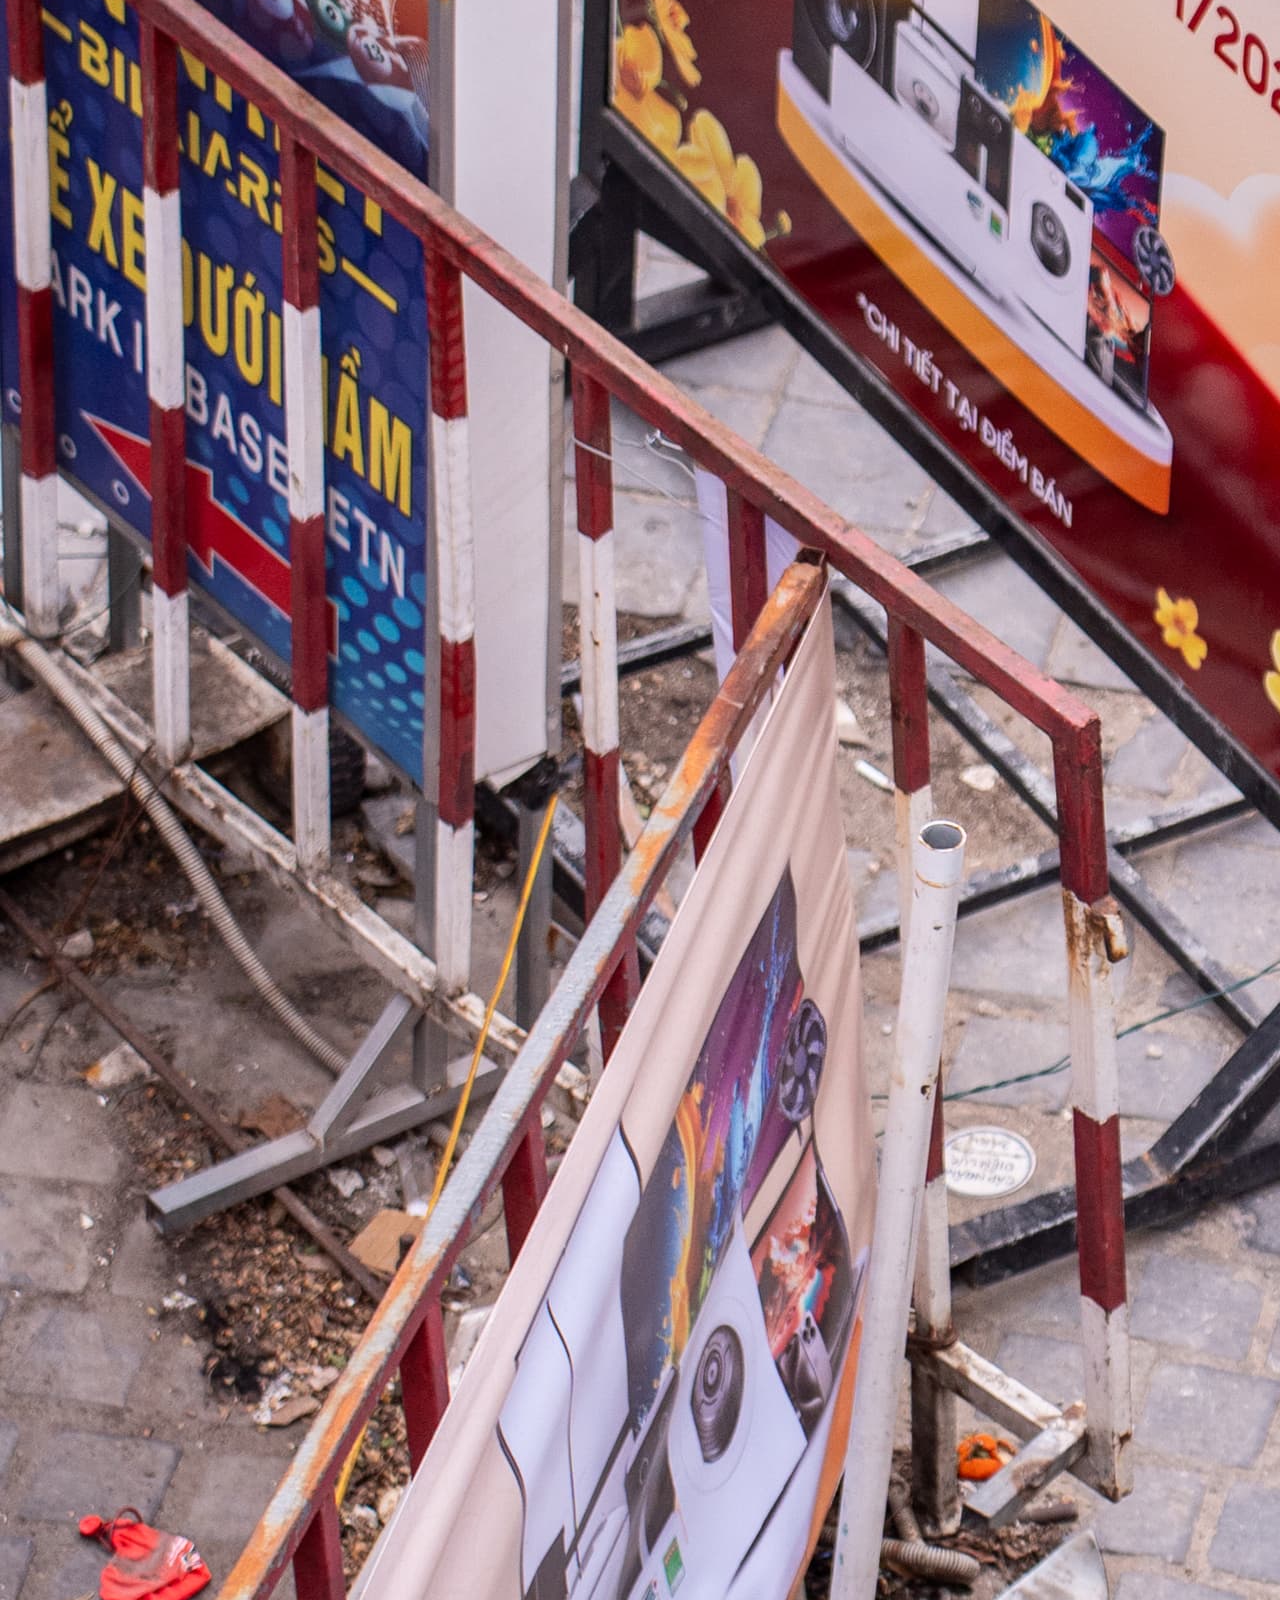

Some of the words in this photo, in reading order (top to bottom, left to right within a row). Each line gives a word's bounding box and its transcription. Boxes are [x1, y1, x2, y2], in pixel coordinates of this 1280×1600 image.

[322, 343, 413, 519] ẦM
[903, 335, 943, 394] TIẾT
[944, 378, 978, 433] TẠI
[980, 415, 1029, 482] ĐIỂM
[1030, 465, 1073, 528] BÁN
